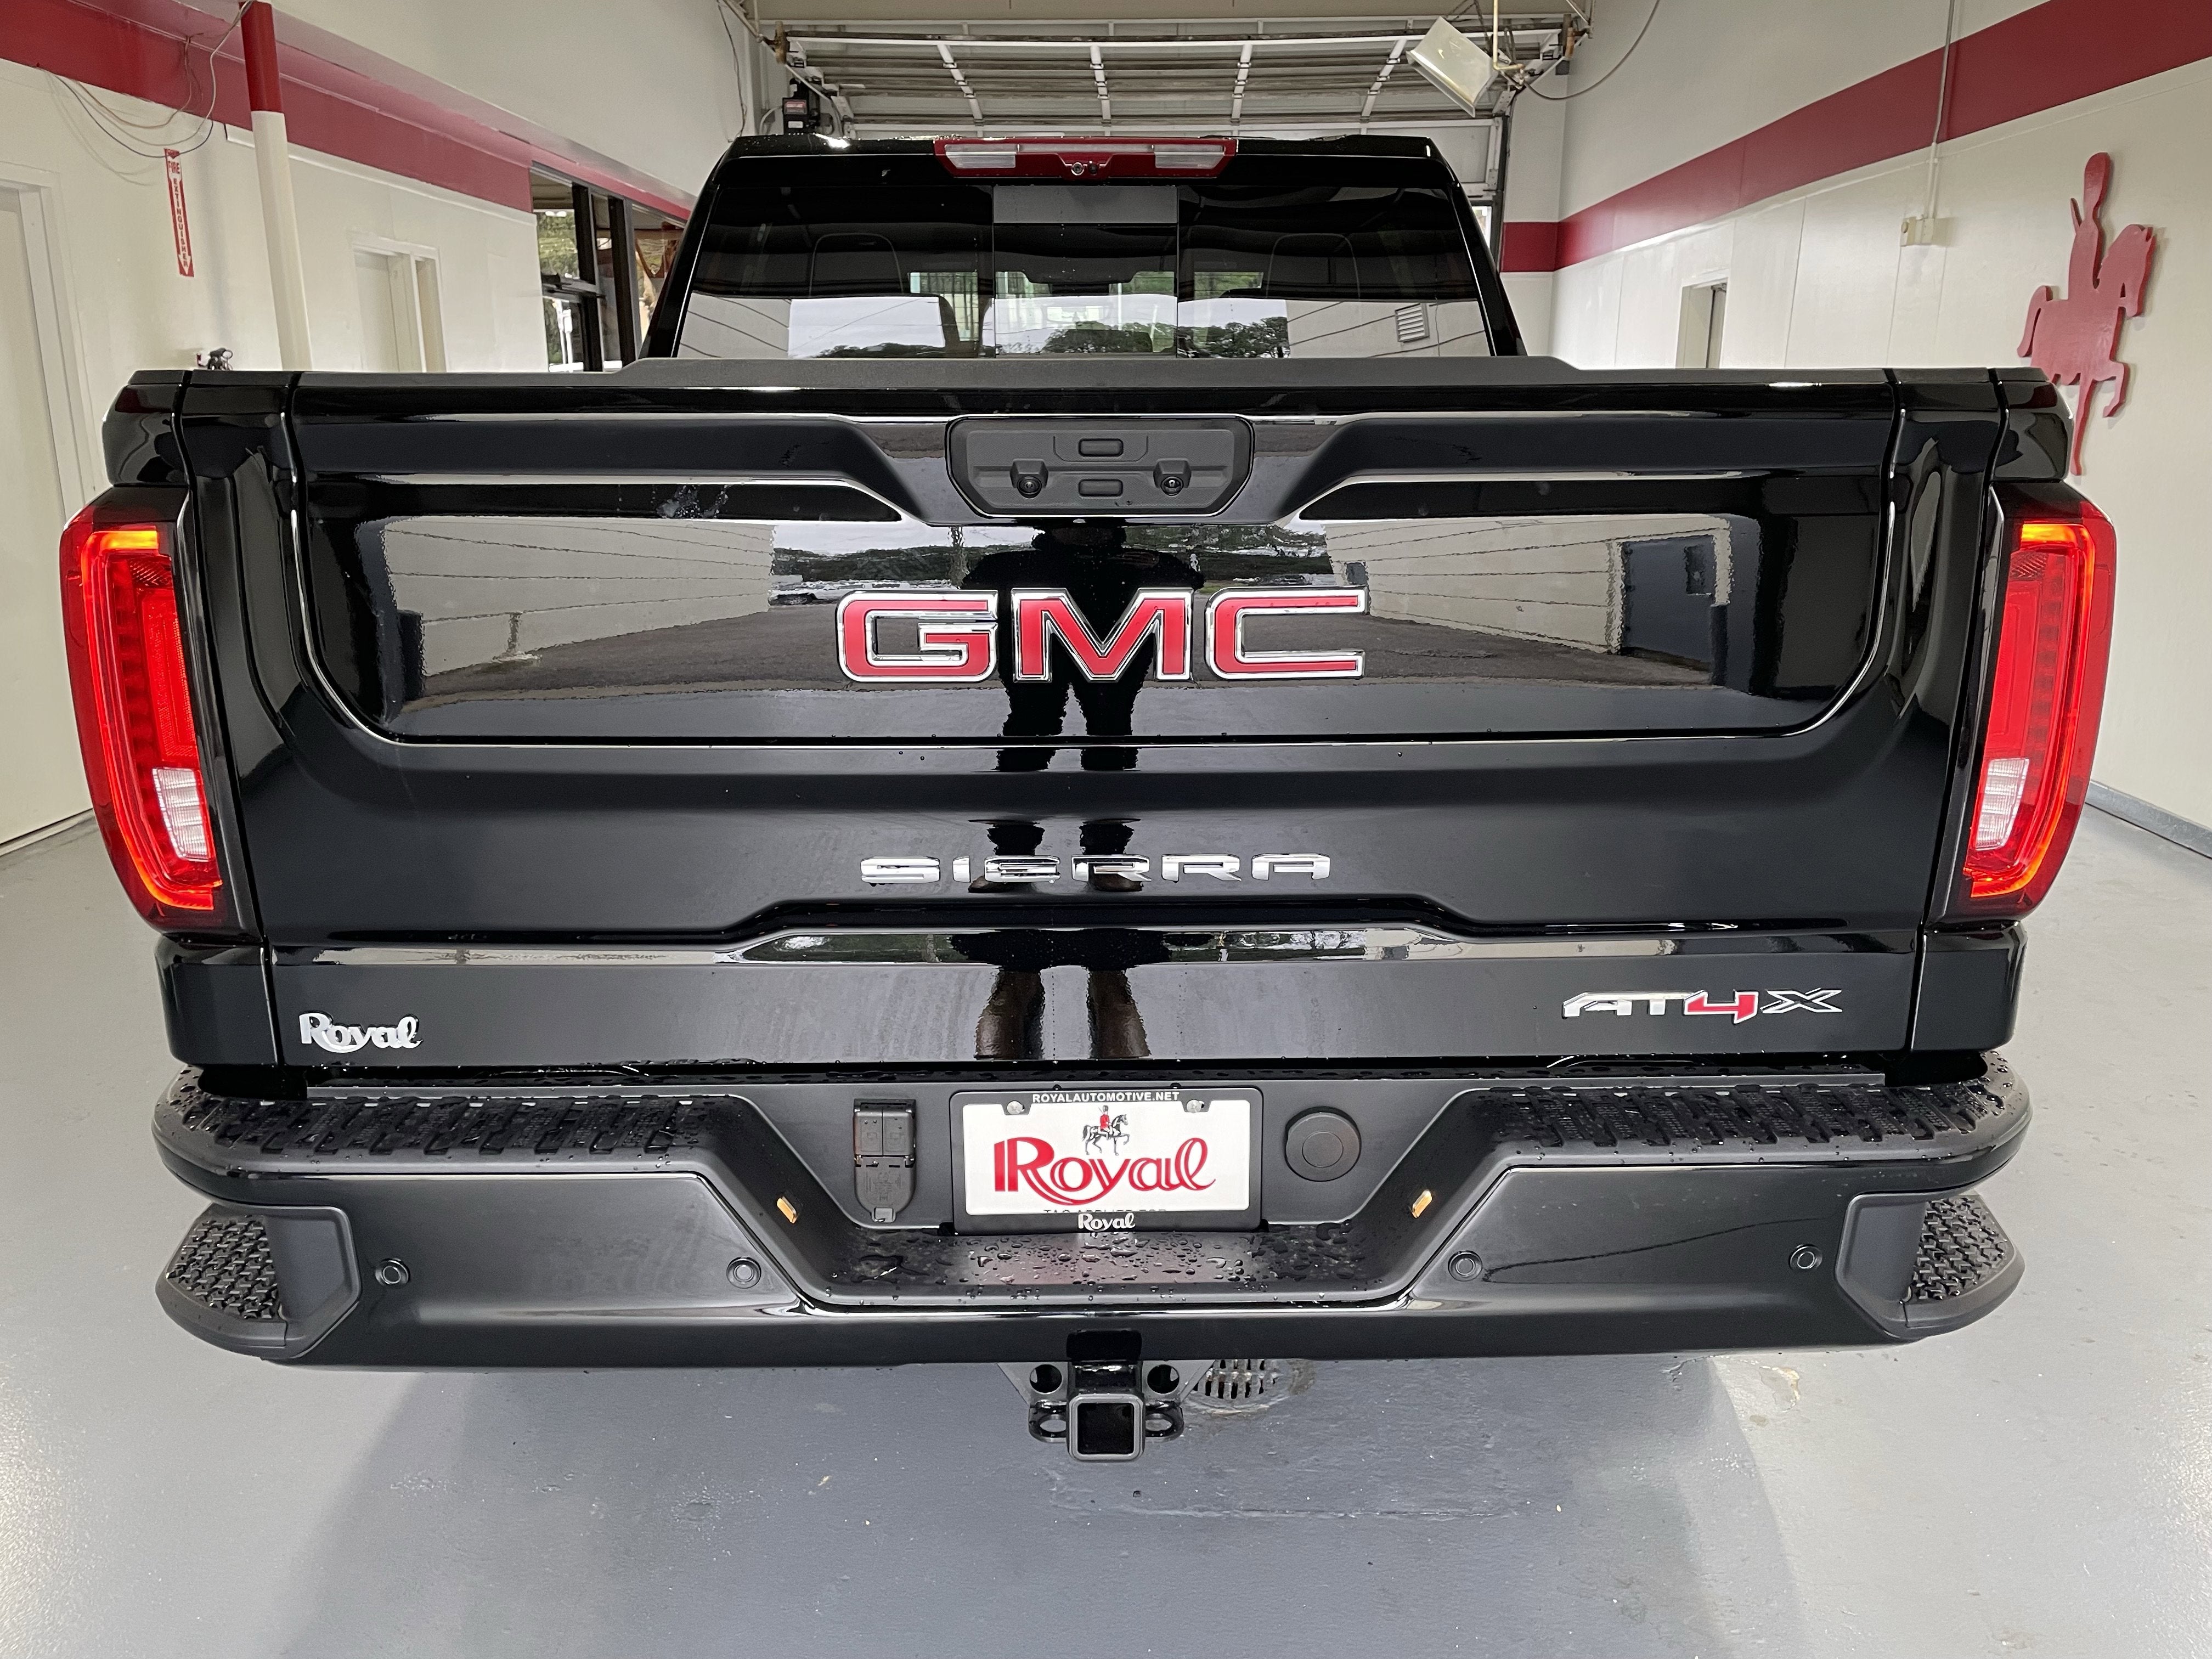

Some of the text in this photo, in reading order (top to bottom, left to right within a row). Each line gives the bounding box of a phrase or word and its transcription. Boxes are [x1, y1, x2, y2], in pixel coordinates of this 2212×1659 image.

[836, 586, 1367, 684] GMC
[860, 853, 1331, 884] SIERRA
[1562, 988, 1843, 1024] AT4X
[298, 1011, 424, 1053] Royal
[1031, 1091, 1180, 1104] ROYALAUTOMOTIVE.NET
[993, 1137, 1216, 1206] Royal
[1077, 1212, 1136, 1232] Royal
